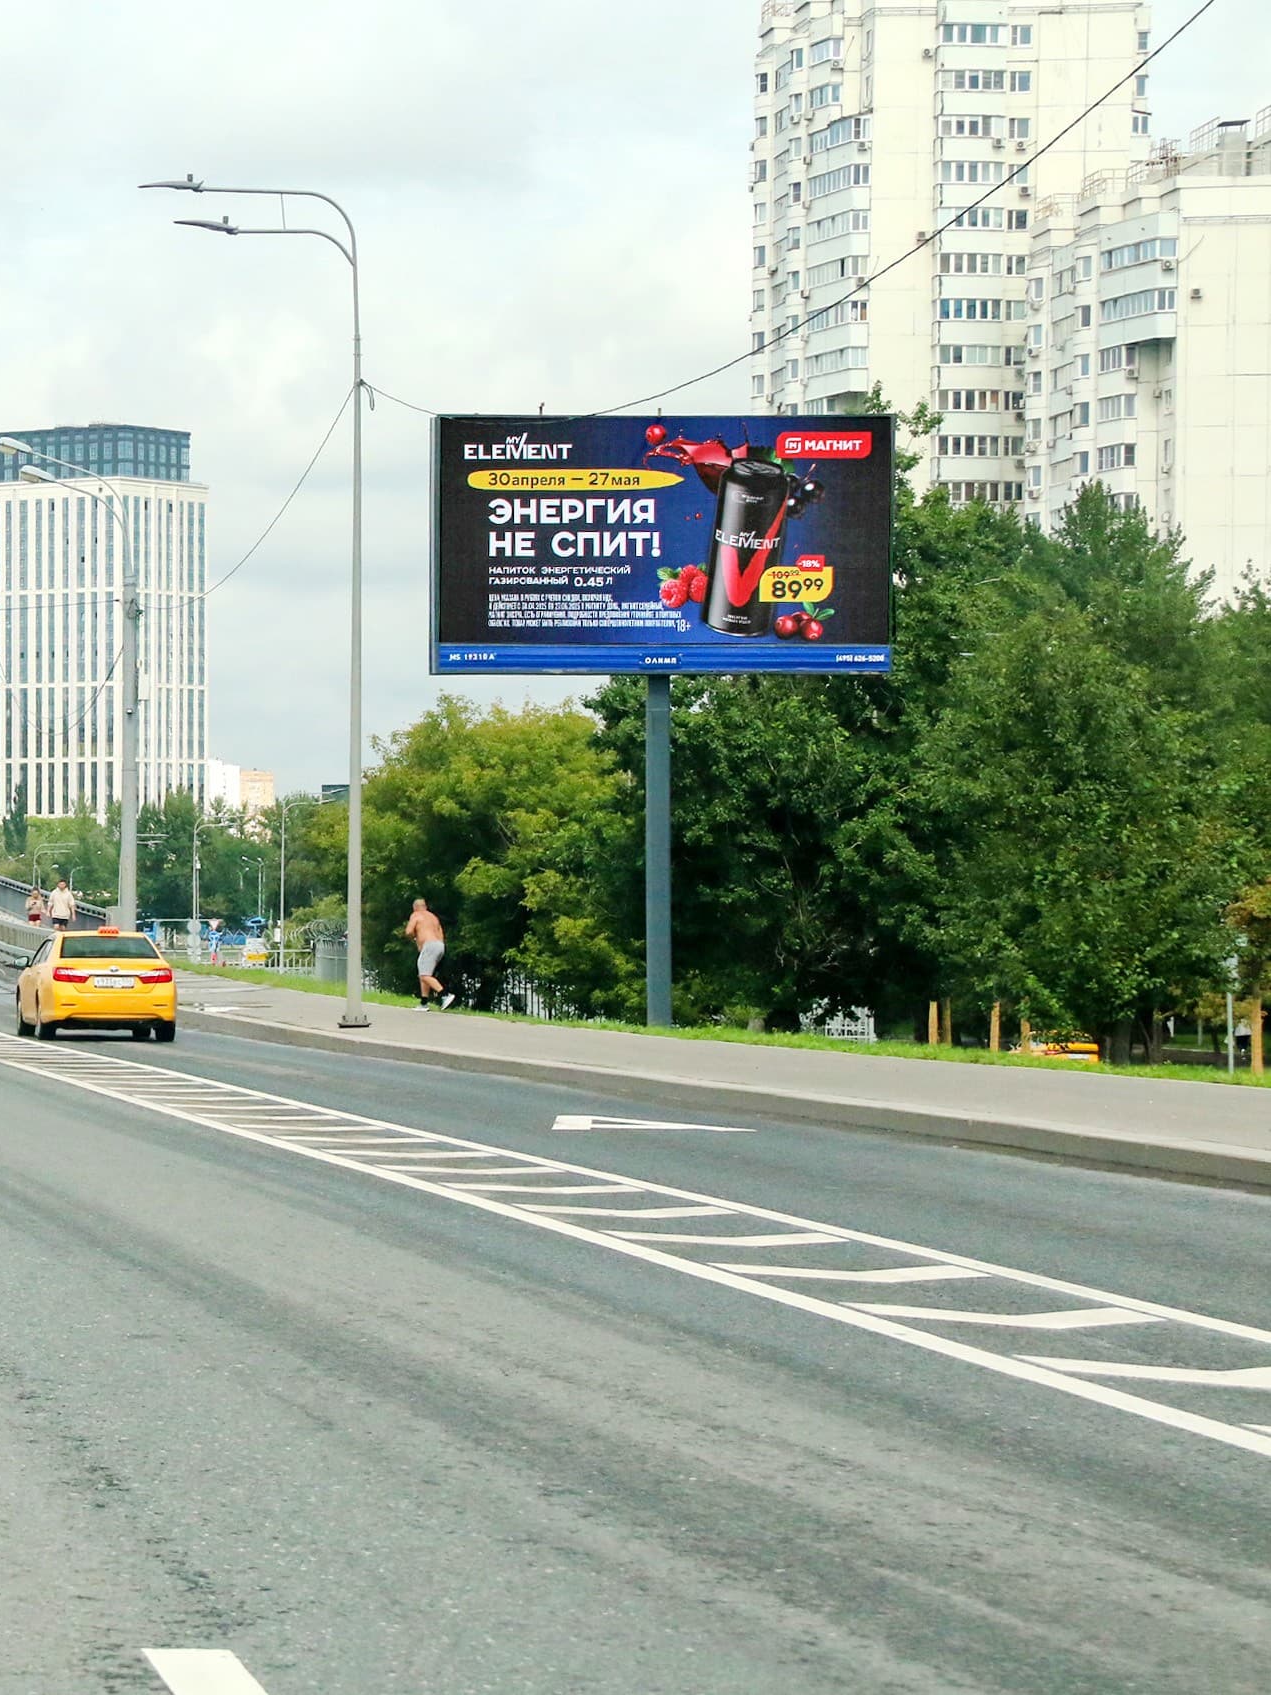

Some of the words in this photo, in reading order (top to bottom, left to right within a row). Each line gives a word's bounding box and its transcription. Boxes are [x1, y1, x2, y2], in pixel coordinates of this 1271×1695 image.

[464, 437, 573, 460] ELEMENT
[804, 439, 863, 451] МАГНИТ
[488, 498, 656, 524] ЭНЕРГИЯ
[488, 531, 536, 557] НЕ
[551, 531, 661, 557] СПИТ!
[715, 529, 780, 550] ELEMENT
[488, 566, 536, 575] НАПИТОК
[541, 565, 631, 575] ЭНЕРГЕТИЧЕСКИЙ
[488, 575, 569, 585] ГАЗИРОВАННЫЙ
[675, 619, 691, 632] 18+
[644, 656, 677, 664] ОЛИМП
